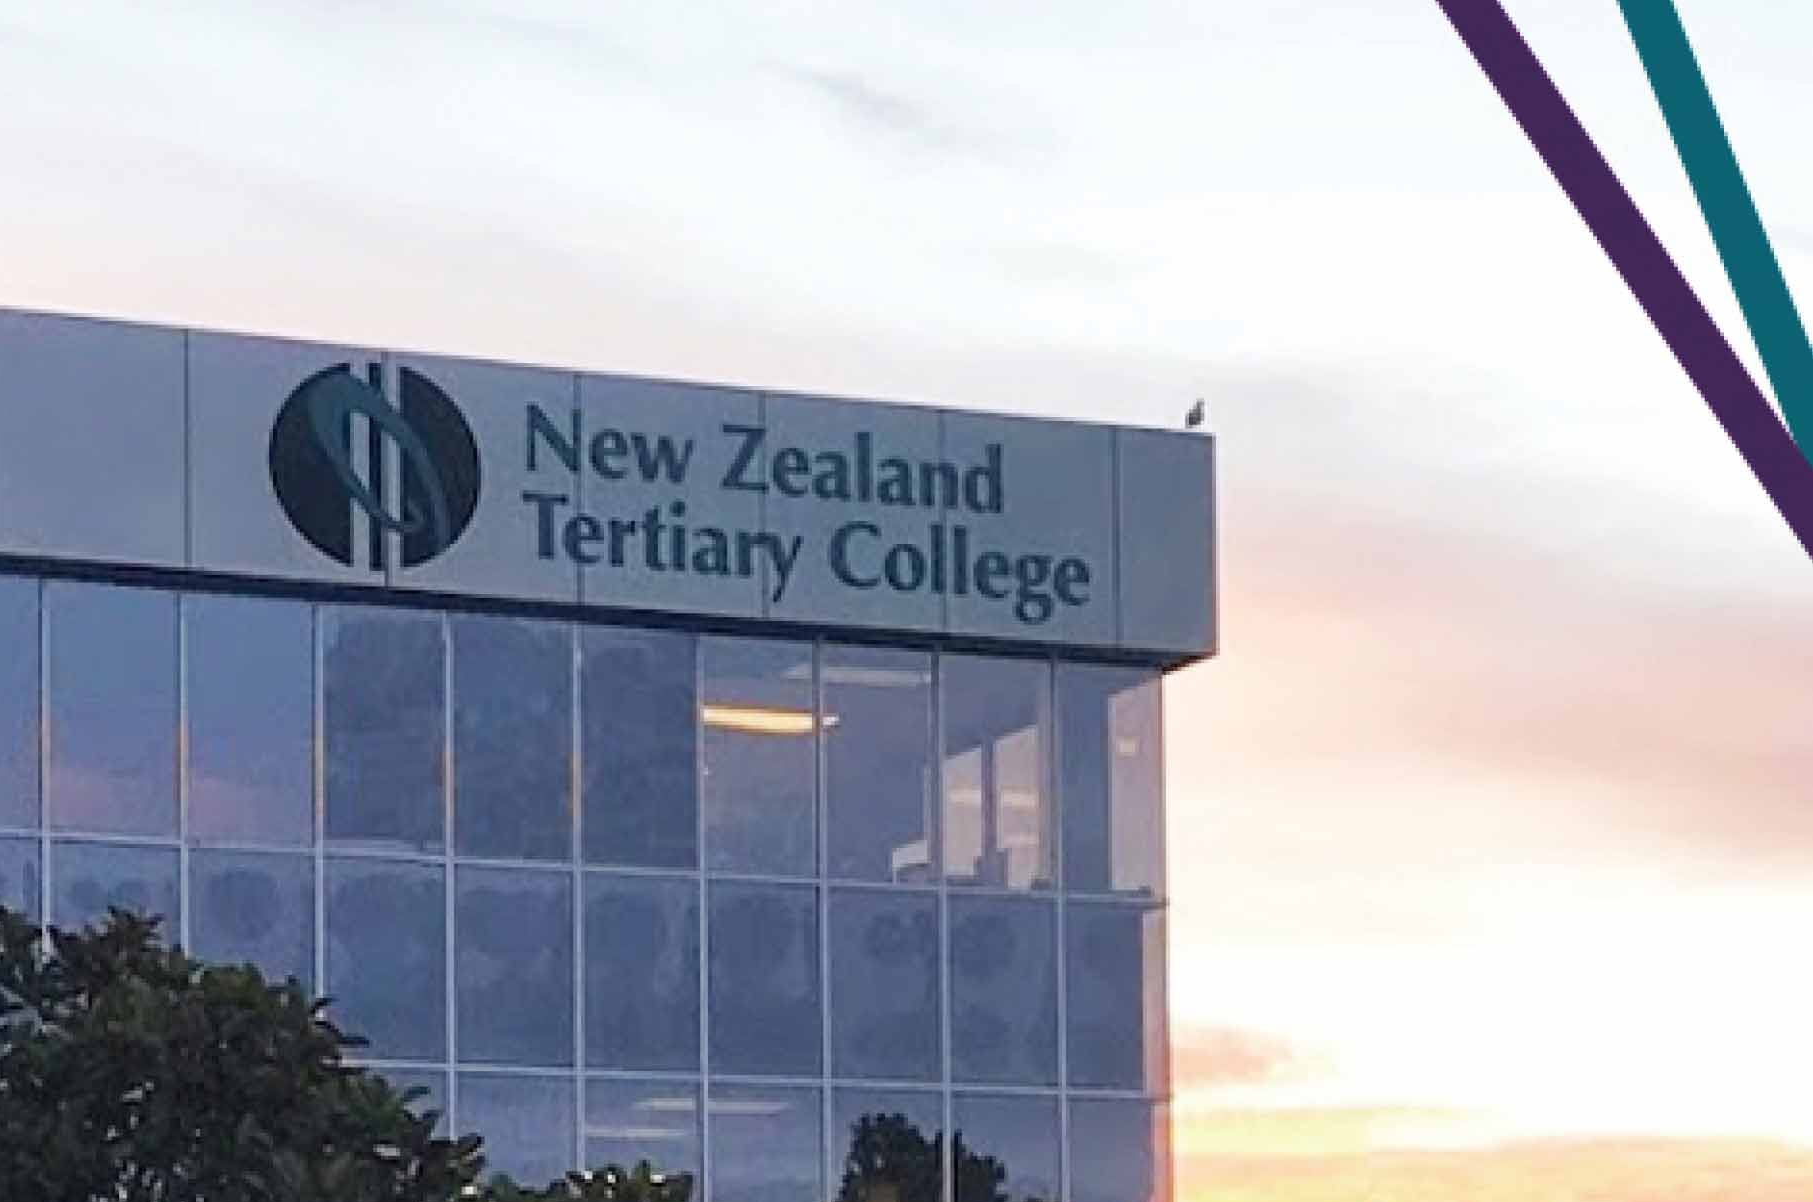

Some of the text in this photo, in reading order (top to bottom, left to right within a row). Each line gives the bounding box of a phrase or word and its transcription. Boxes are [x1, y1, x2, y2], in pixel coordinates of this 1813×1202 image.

[522, 402, 1006, 515] New Zealand
[522, 493, 1092, 627] Tertiary College
